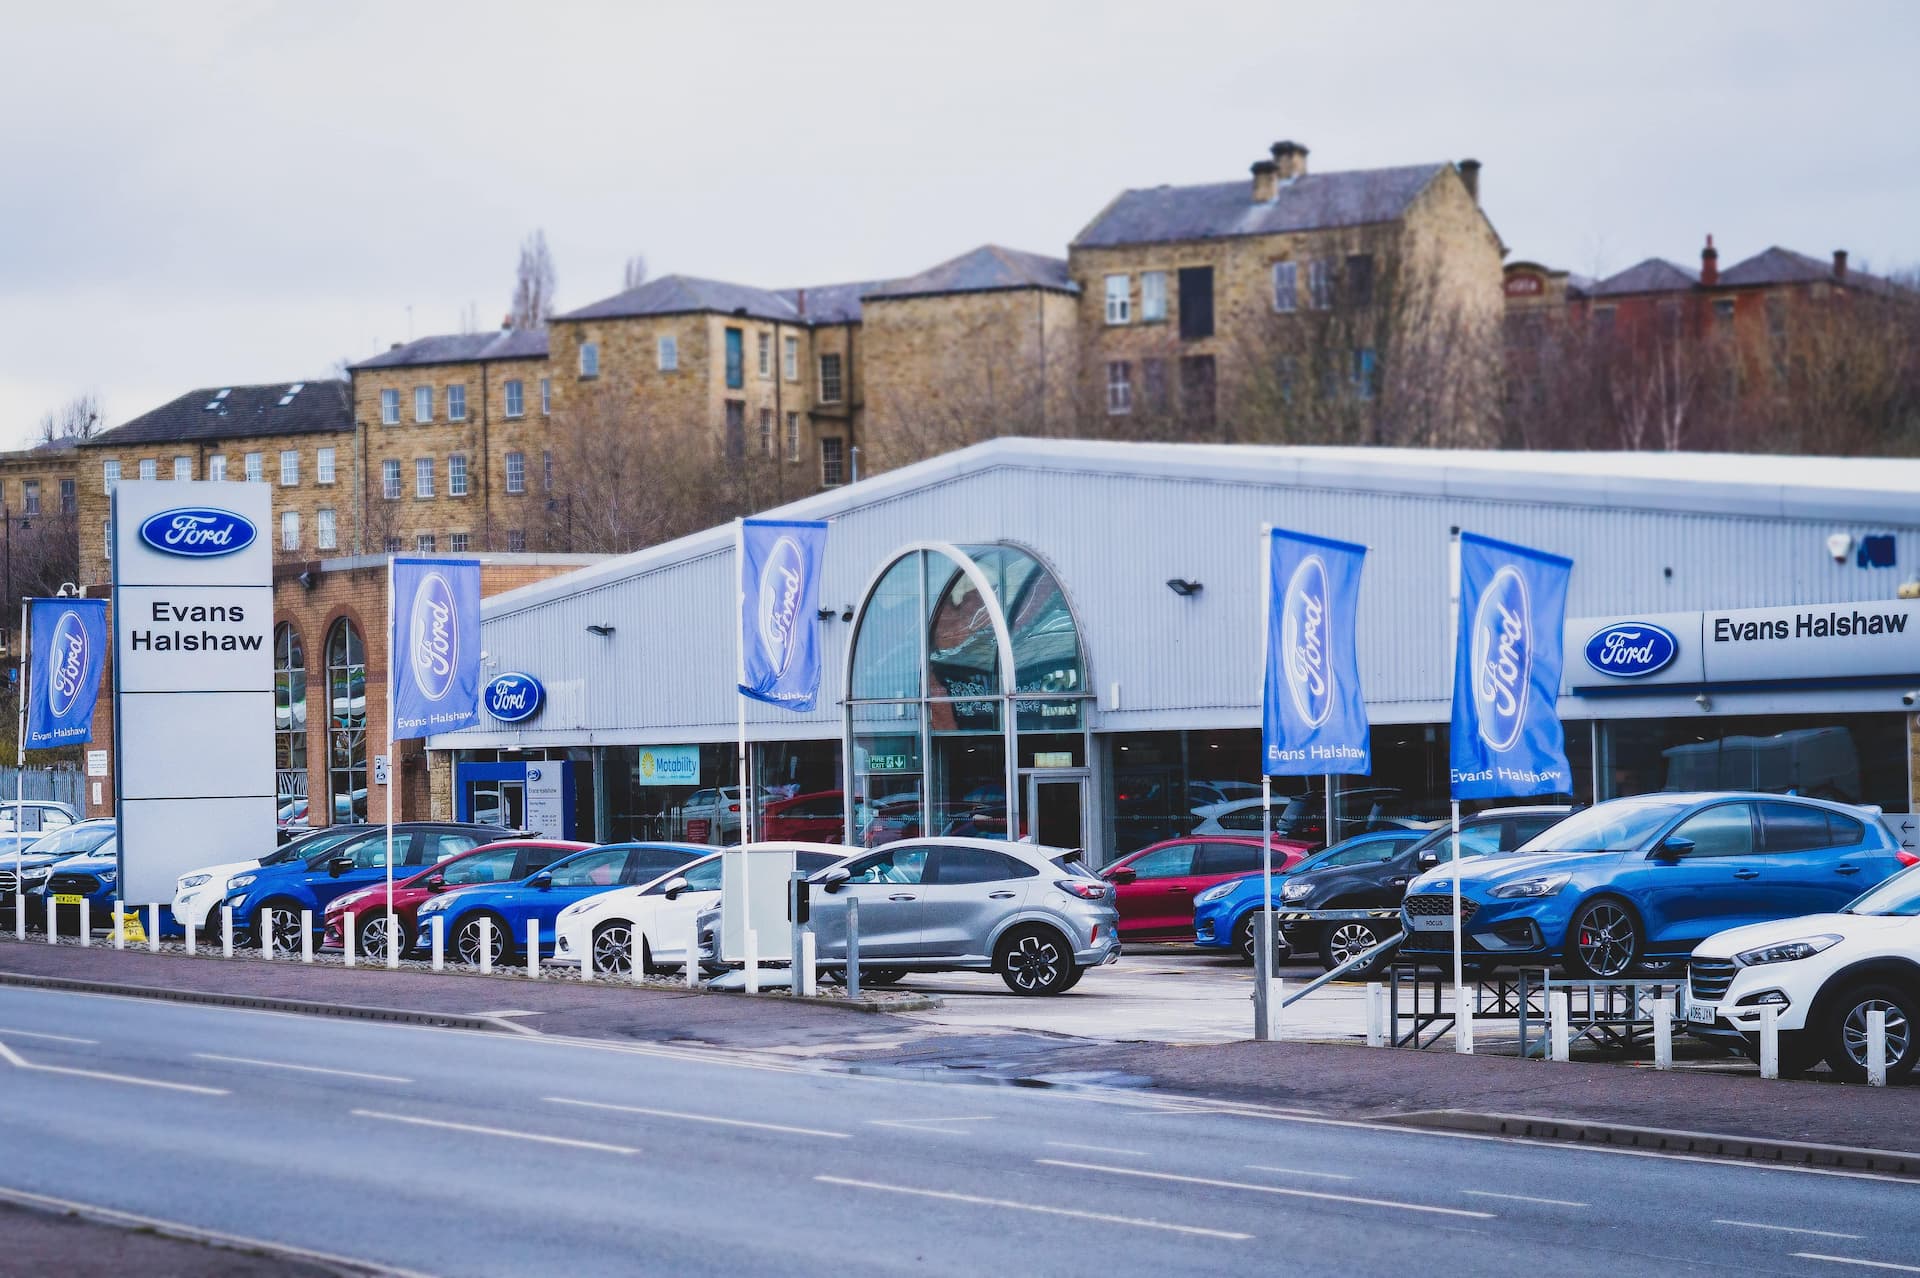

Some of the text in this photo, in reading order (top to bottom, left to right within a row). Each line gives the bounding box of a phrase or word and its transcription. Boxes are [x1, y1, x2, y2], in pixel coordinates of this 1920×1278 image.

[165, 515, 234, 546] Ford
[152, 602, 244, 622] Evans
[770, 566, 800, 648] Ford
[131, 630, 263, 651] Halshaw
[417, 600, 449, 675] Ford
[1714, 610, 1908, 642] Evans Halshaw
[1291, 590, 1323, 696] Ford
[1600, 631, 1654, 665] Ford
[54, 633, 84, 697] Ford
[1481, 602, 1521, 717] Ford
[493, 680, 528, 711] Ford
[32, 726, 87, 742] Evans Halshaw
[397, 710, 474, 729] Evans Halshaw
[656, 756, 697, 776] Motability
[1268, 744, 1366, 761] Evans Halshaw
[1450, 766, 1561, 784] Evans Halshaw
